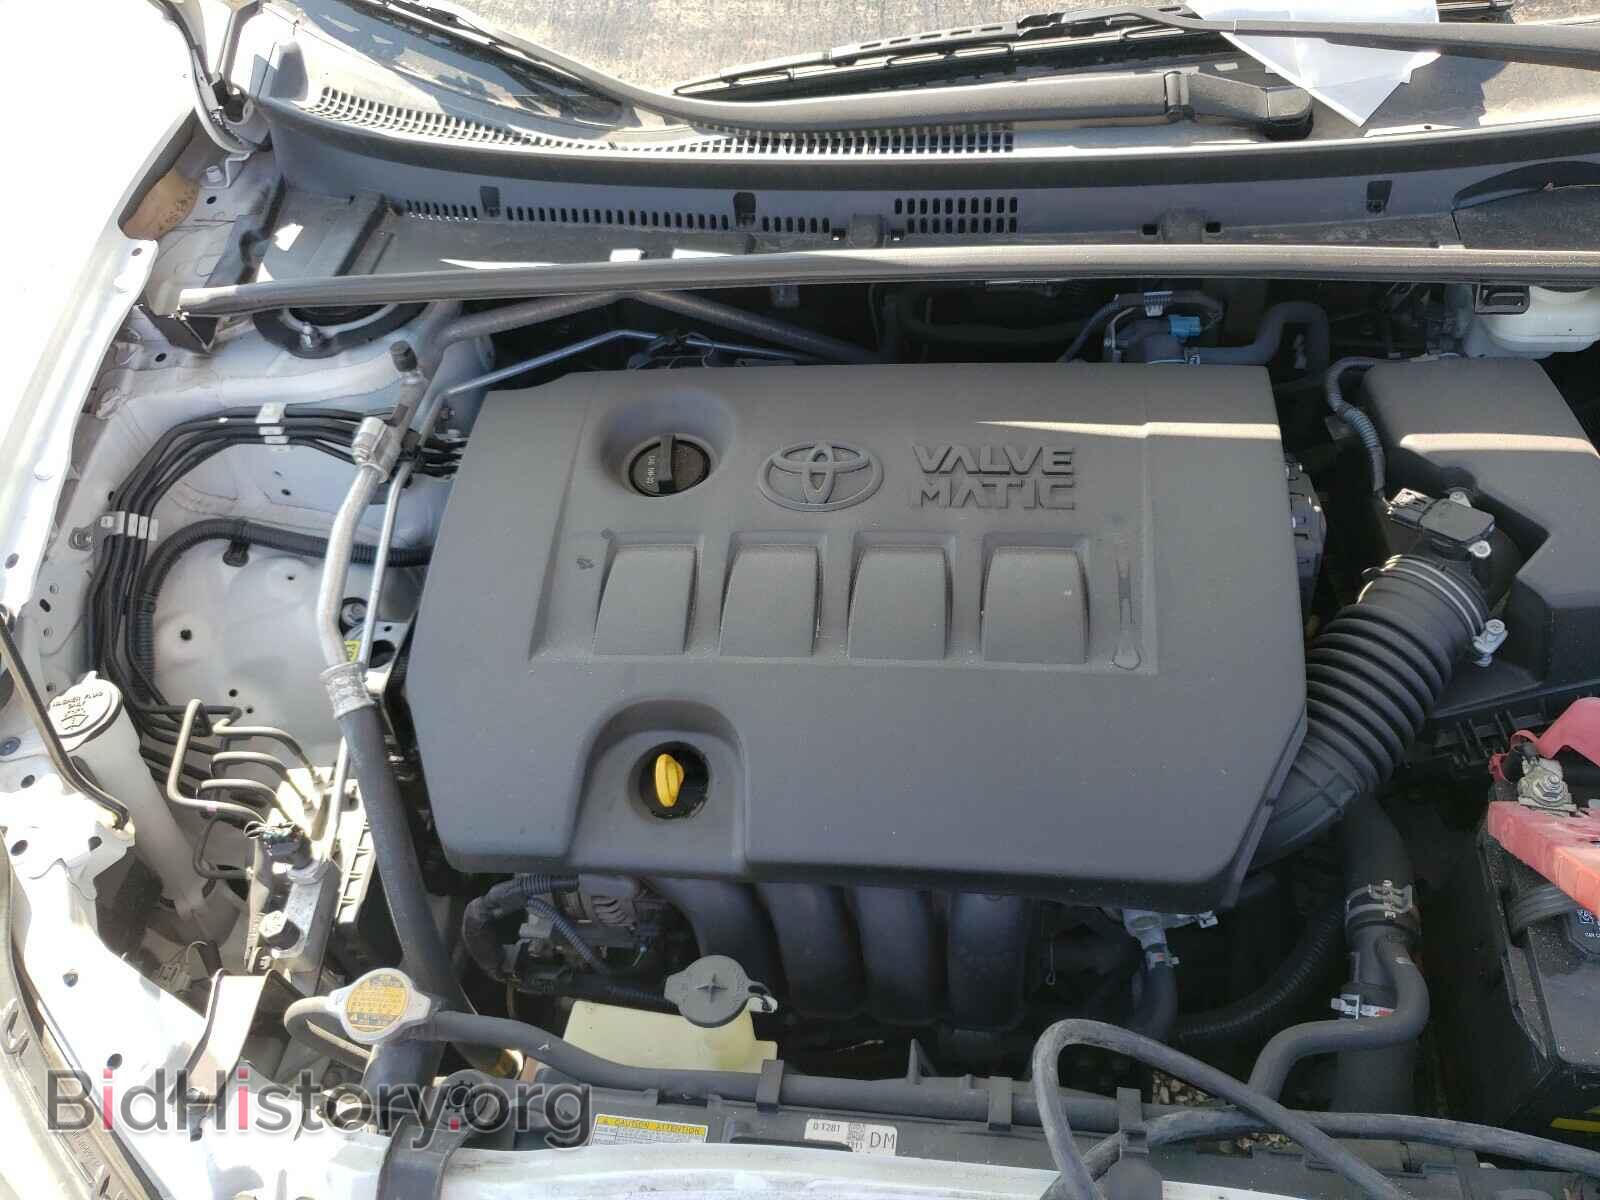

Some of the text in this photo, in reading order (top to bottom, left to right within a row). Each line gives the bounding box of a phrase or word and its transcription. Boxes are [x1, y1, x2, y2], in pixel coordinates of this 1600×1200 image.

[911, 444, 1075, 475] VALVE
[911, 478, 1076, 511] MATIC
[870, 1131, 896, 1150] DM
